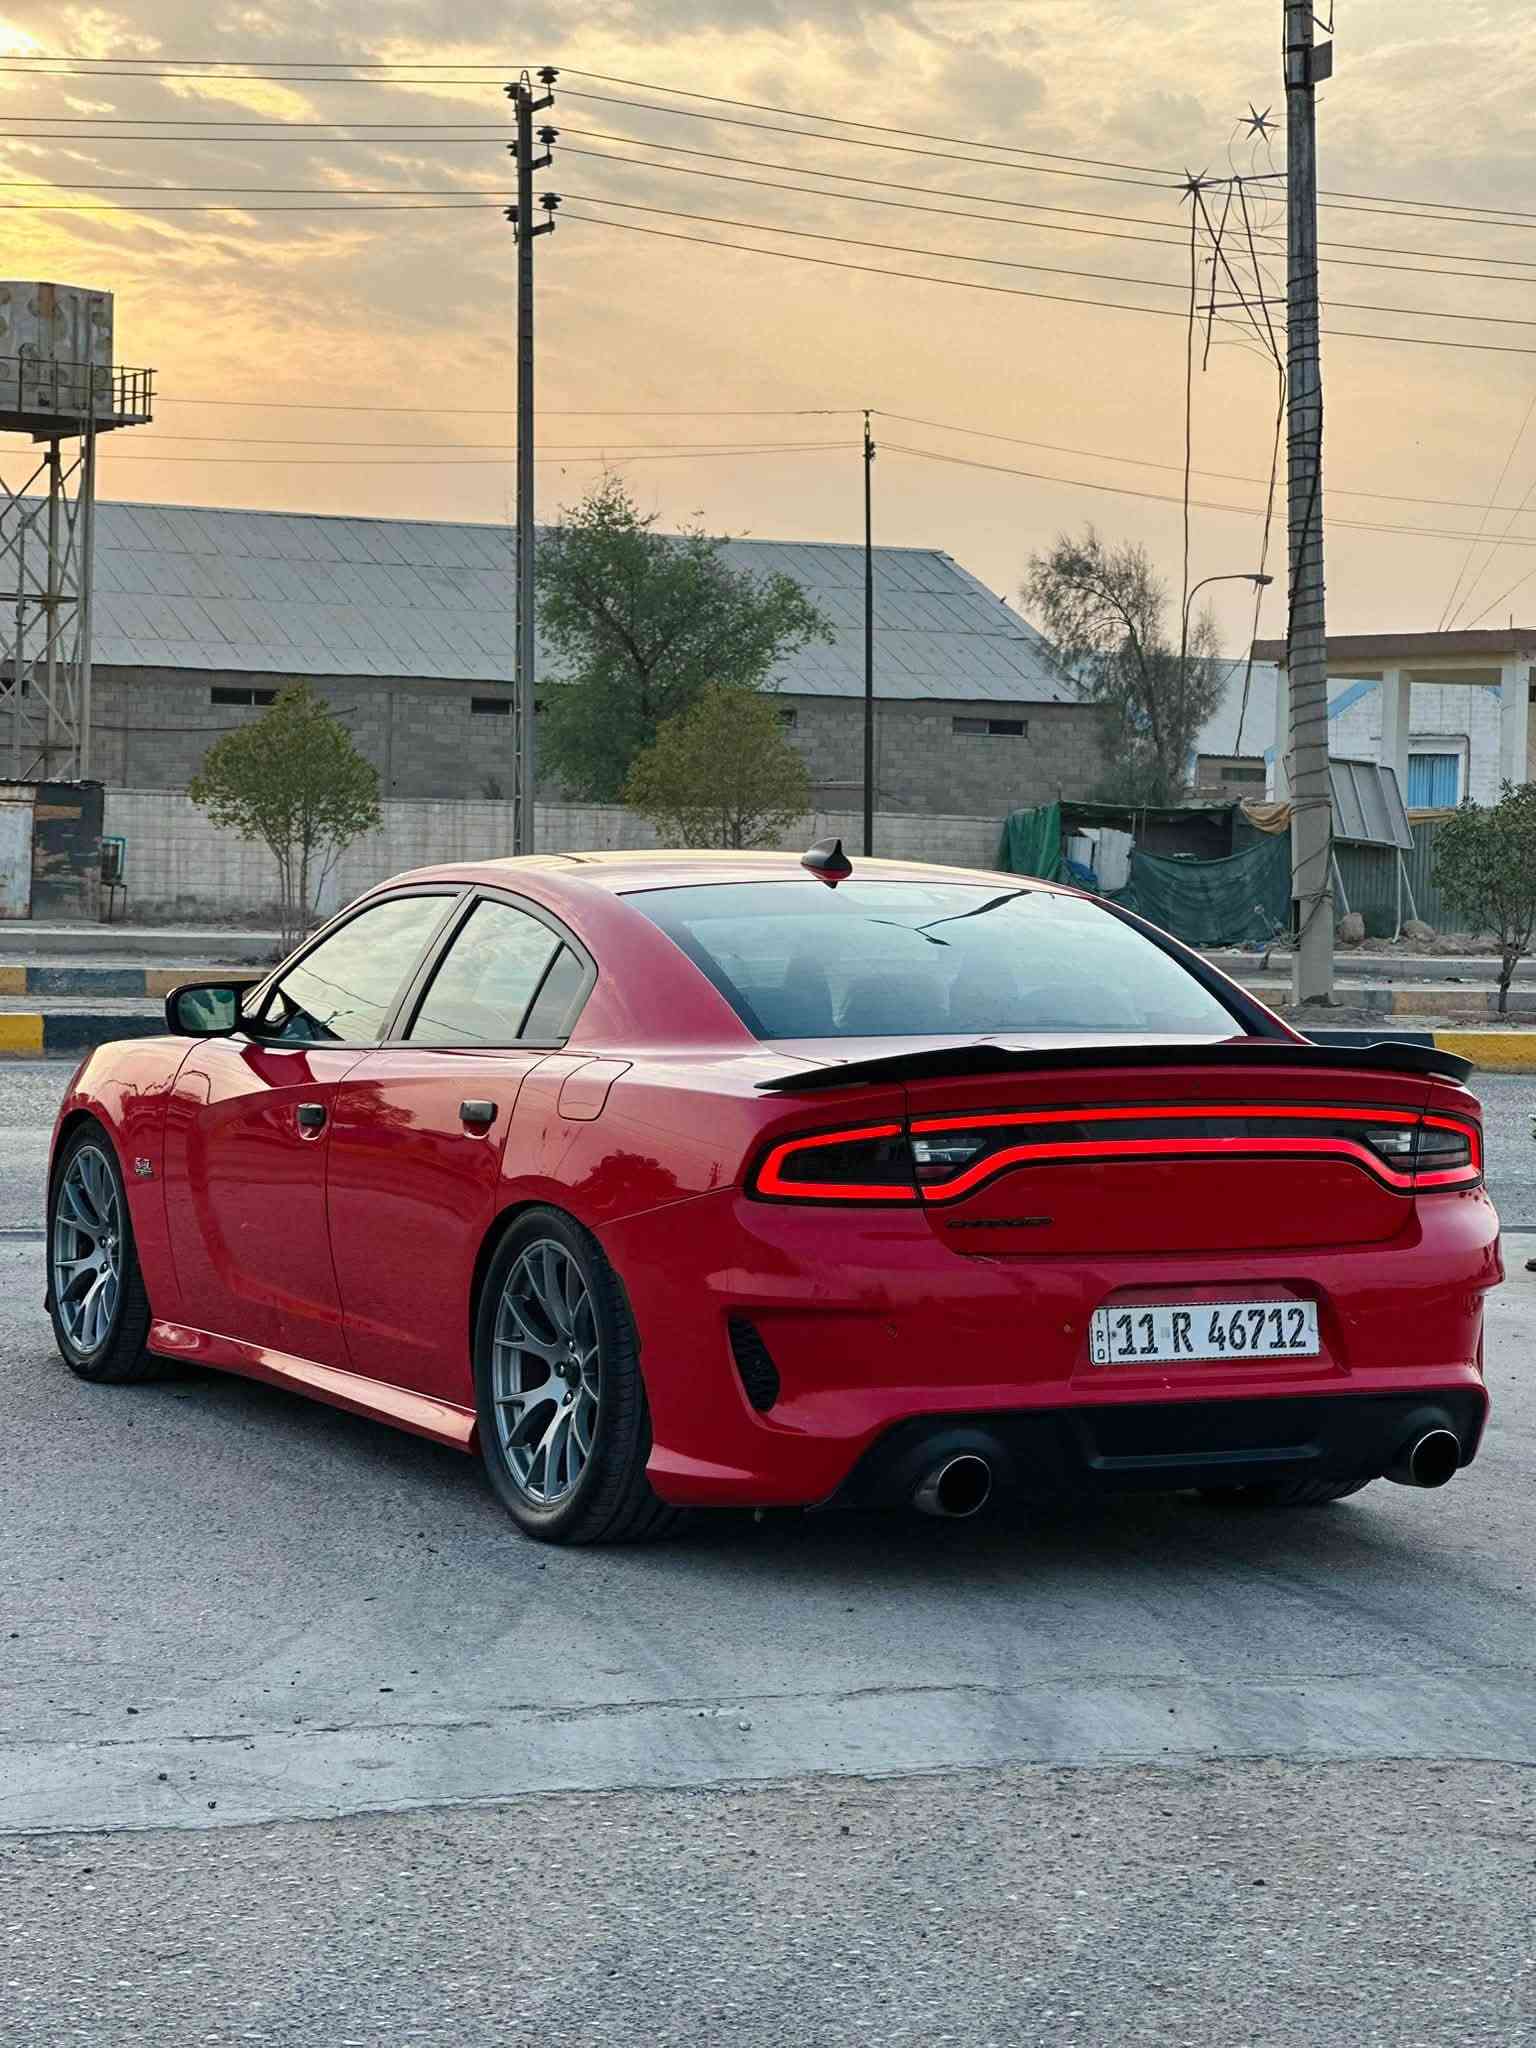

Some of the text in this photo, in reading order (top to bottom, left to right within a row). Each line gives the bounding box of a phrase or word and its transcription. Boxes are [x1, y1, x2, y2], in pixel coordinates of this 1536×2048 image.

[1116, 1308, 1306, 1356] 11 R 46712
